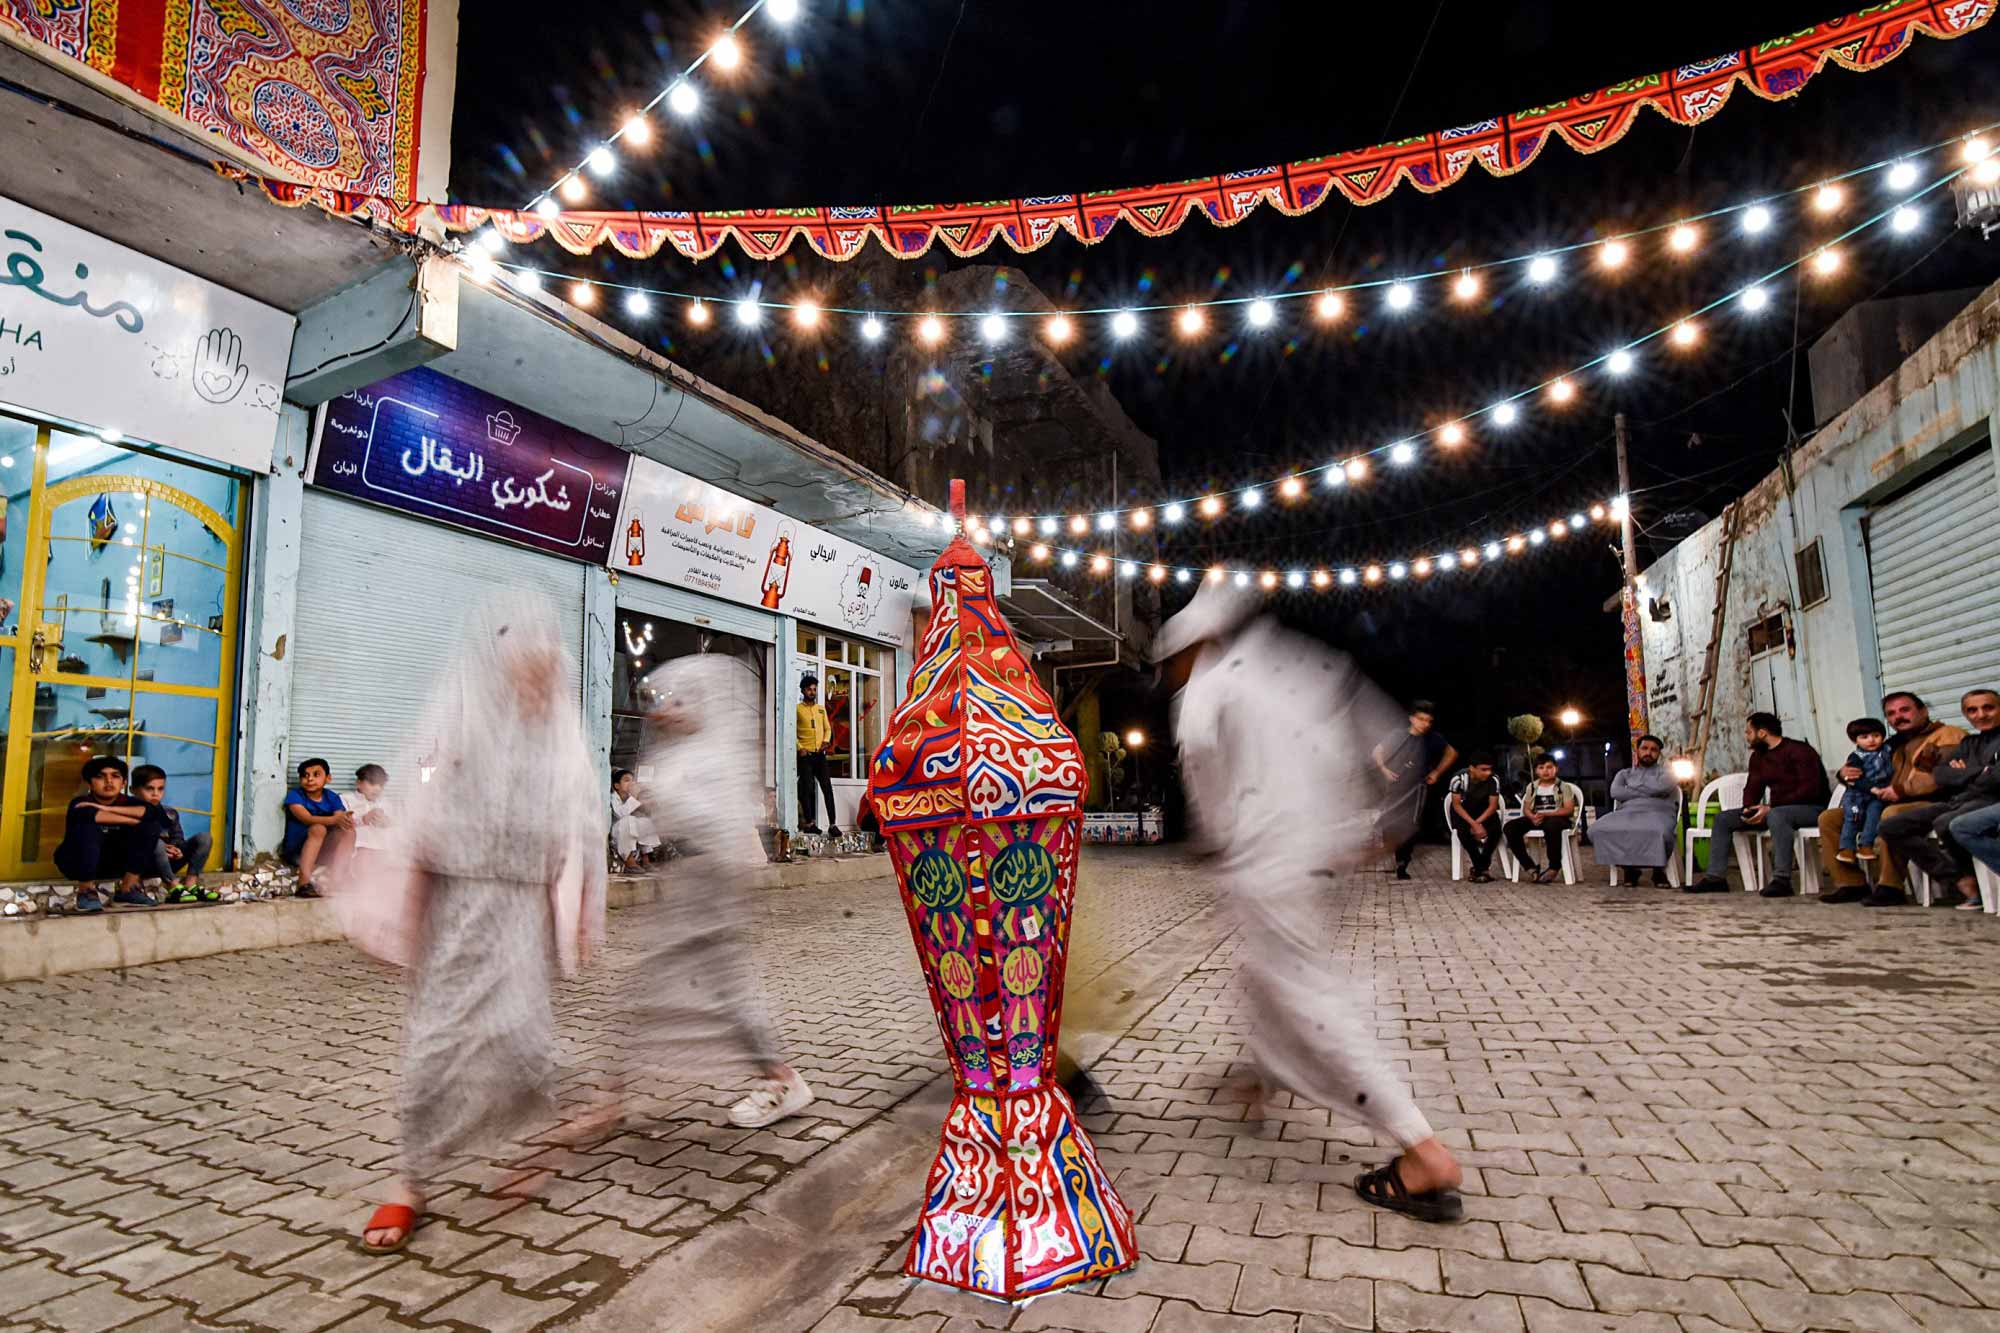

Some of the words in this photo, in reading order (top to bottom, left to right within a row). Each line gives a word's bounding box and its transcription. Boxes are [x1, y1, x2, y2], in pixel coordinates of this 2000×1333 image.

[402, 436, 484, 486] البقال
[491, 469, 571, 510] شكوري
[810, 544, 836, 562] الرجالي
[889, 576, 909, 590] صالون
